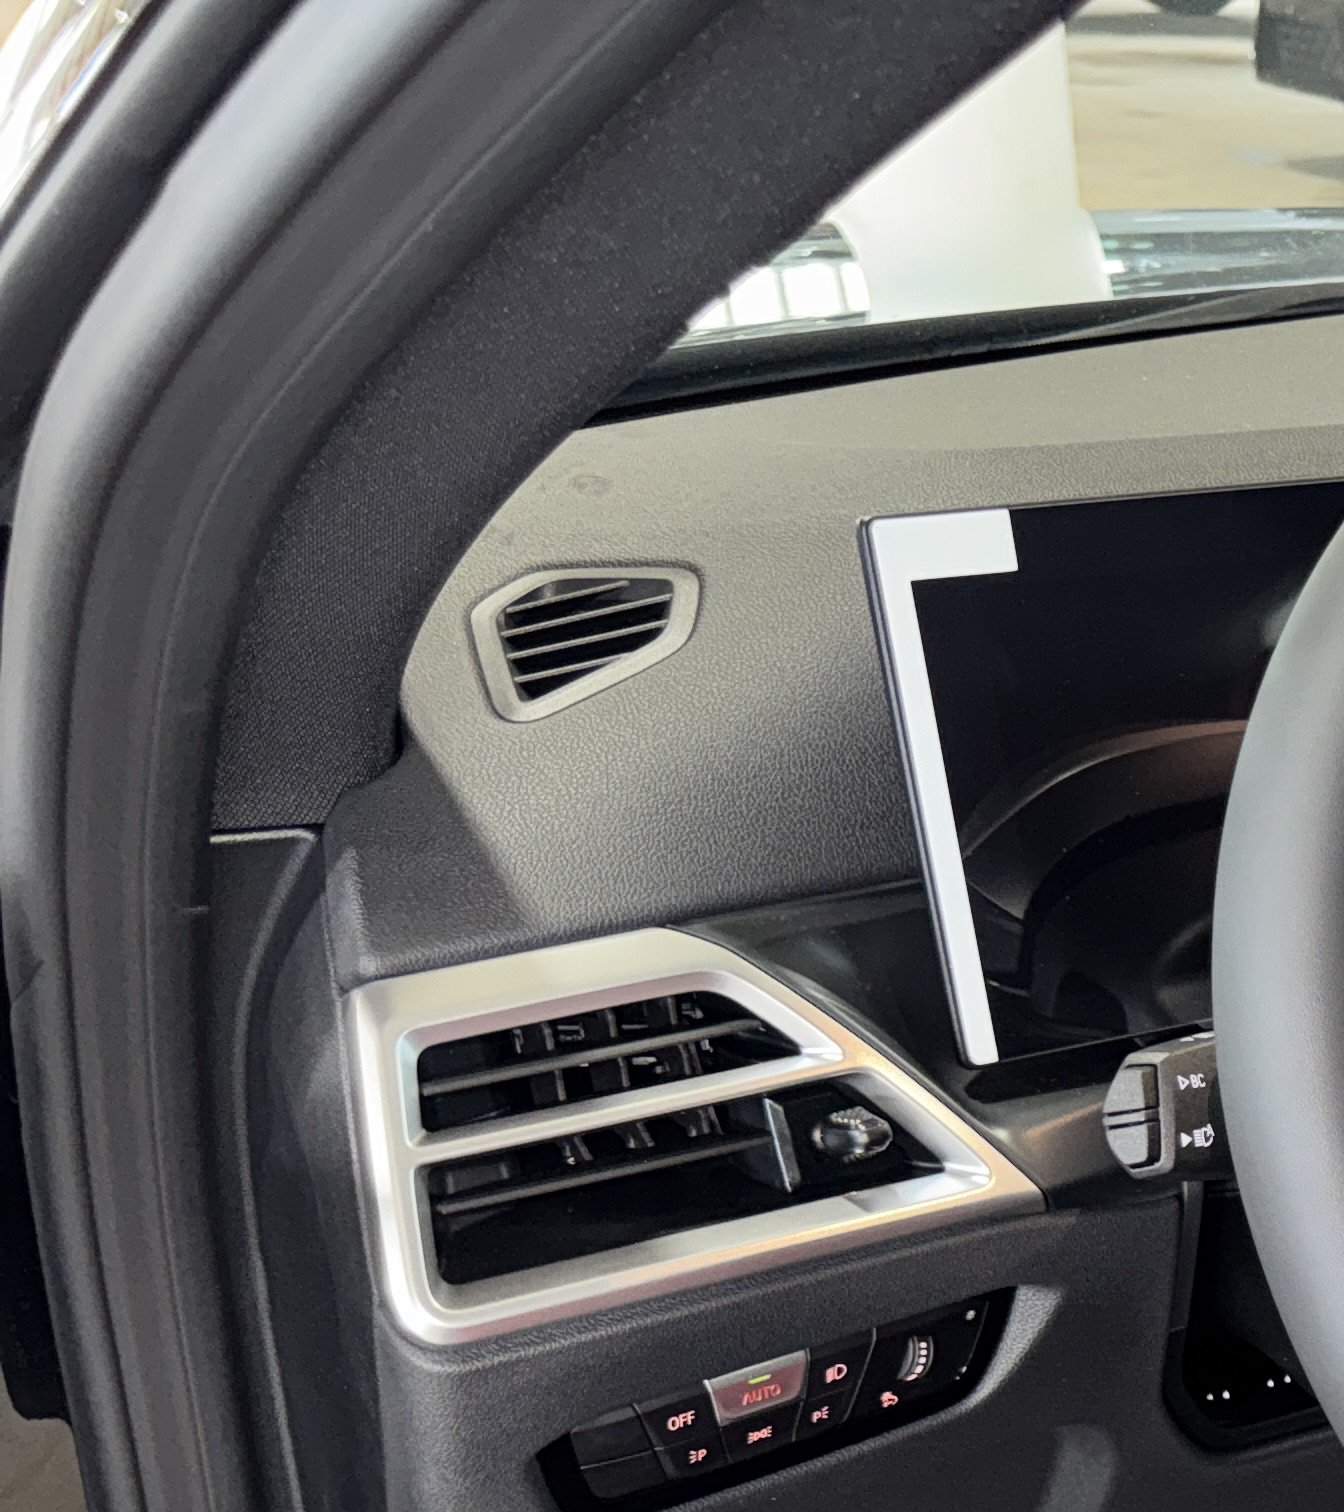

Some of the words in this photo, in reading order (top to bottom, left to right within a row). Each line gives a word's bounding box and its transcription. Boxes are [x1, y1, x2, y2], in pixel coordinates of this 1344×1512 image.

[1189, 1073, 1206, 1089] BC
[742, 1384, 782, 1406] AUTO
[666, 1410, 696, 1431] OFF
